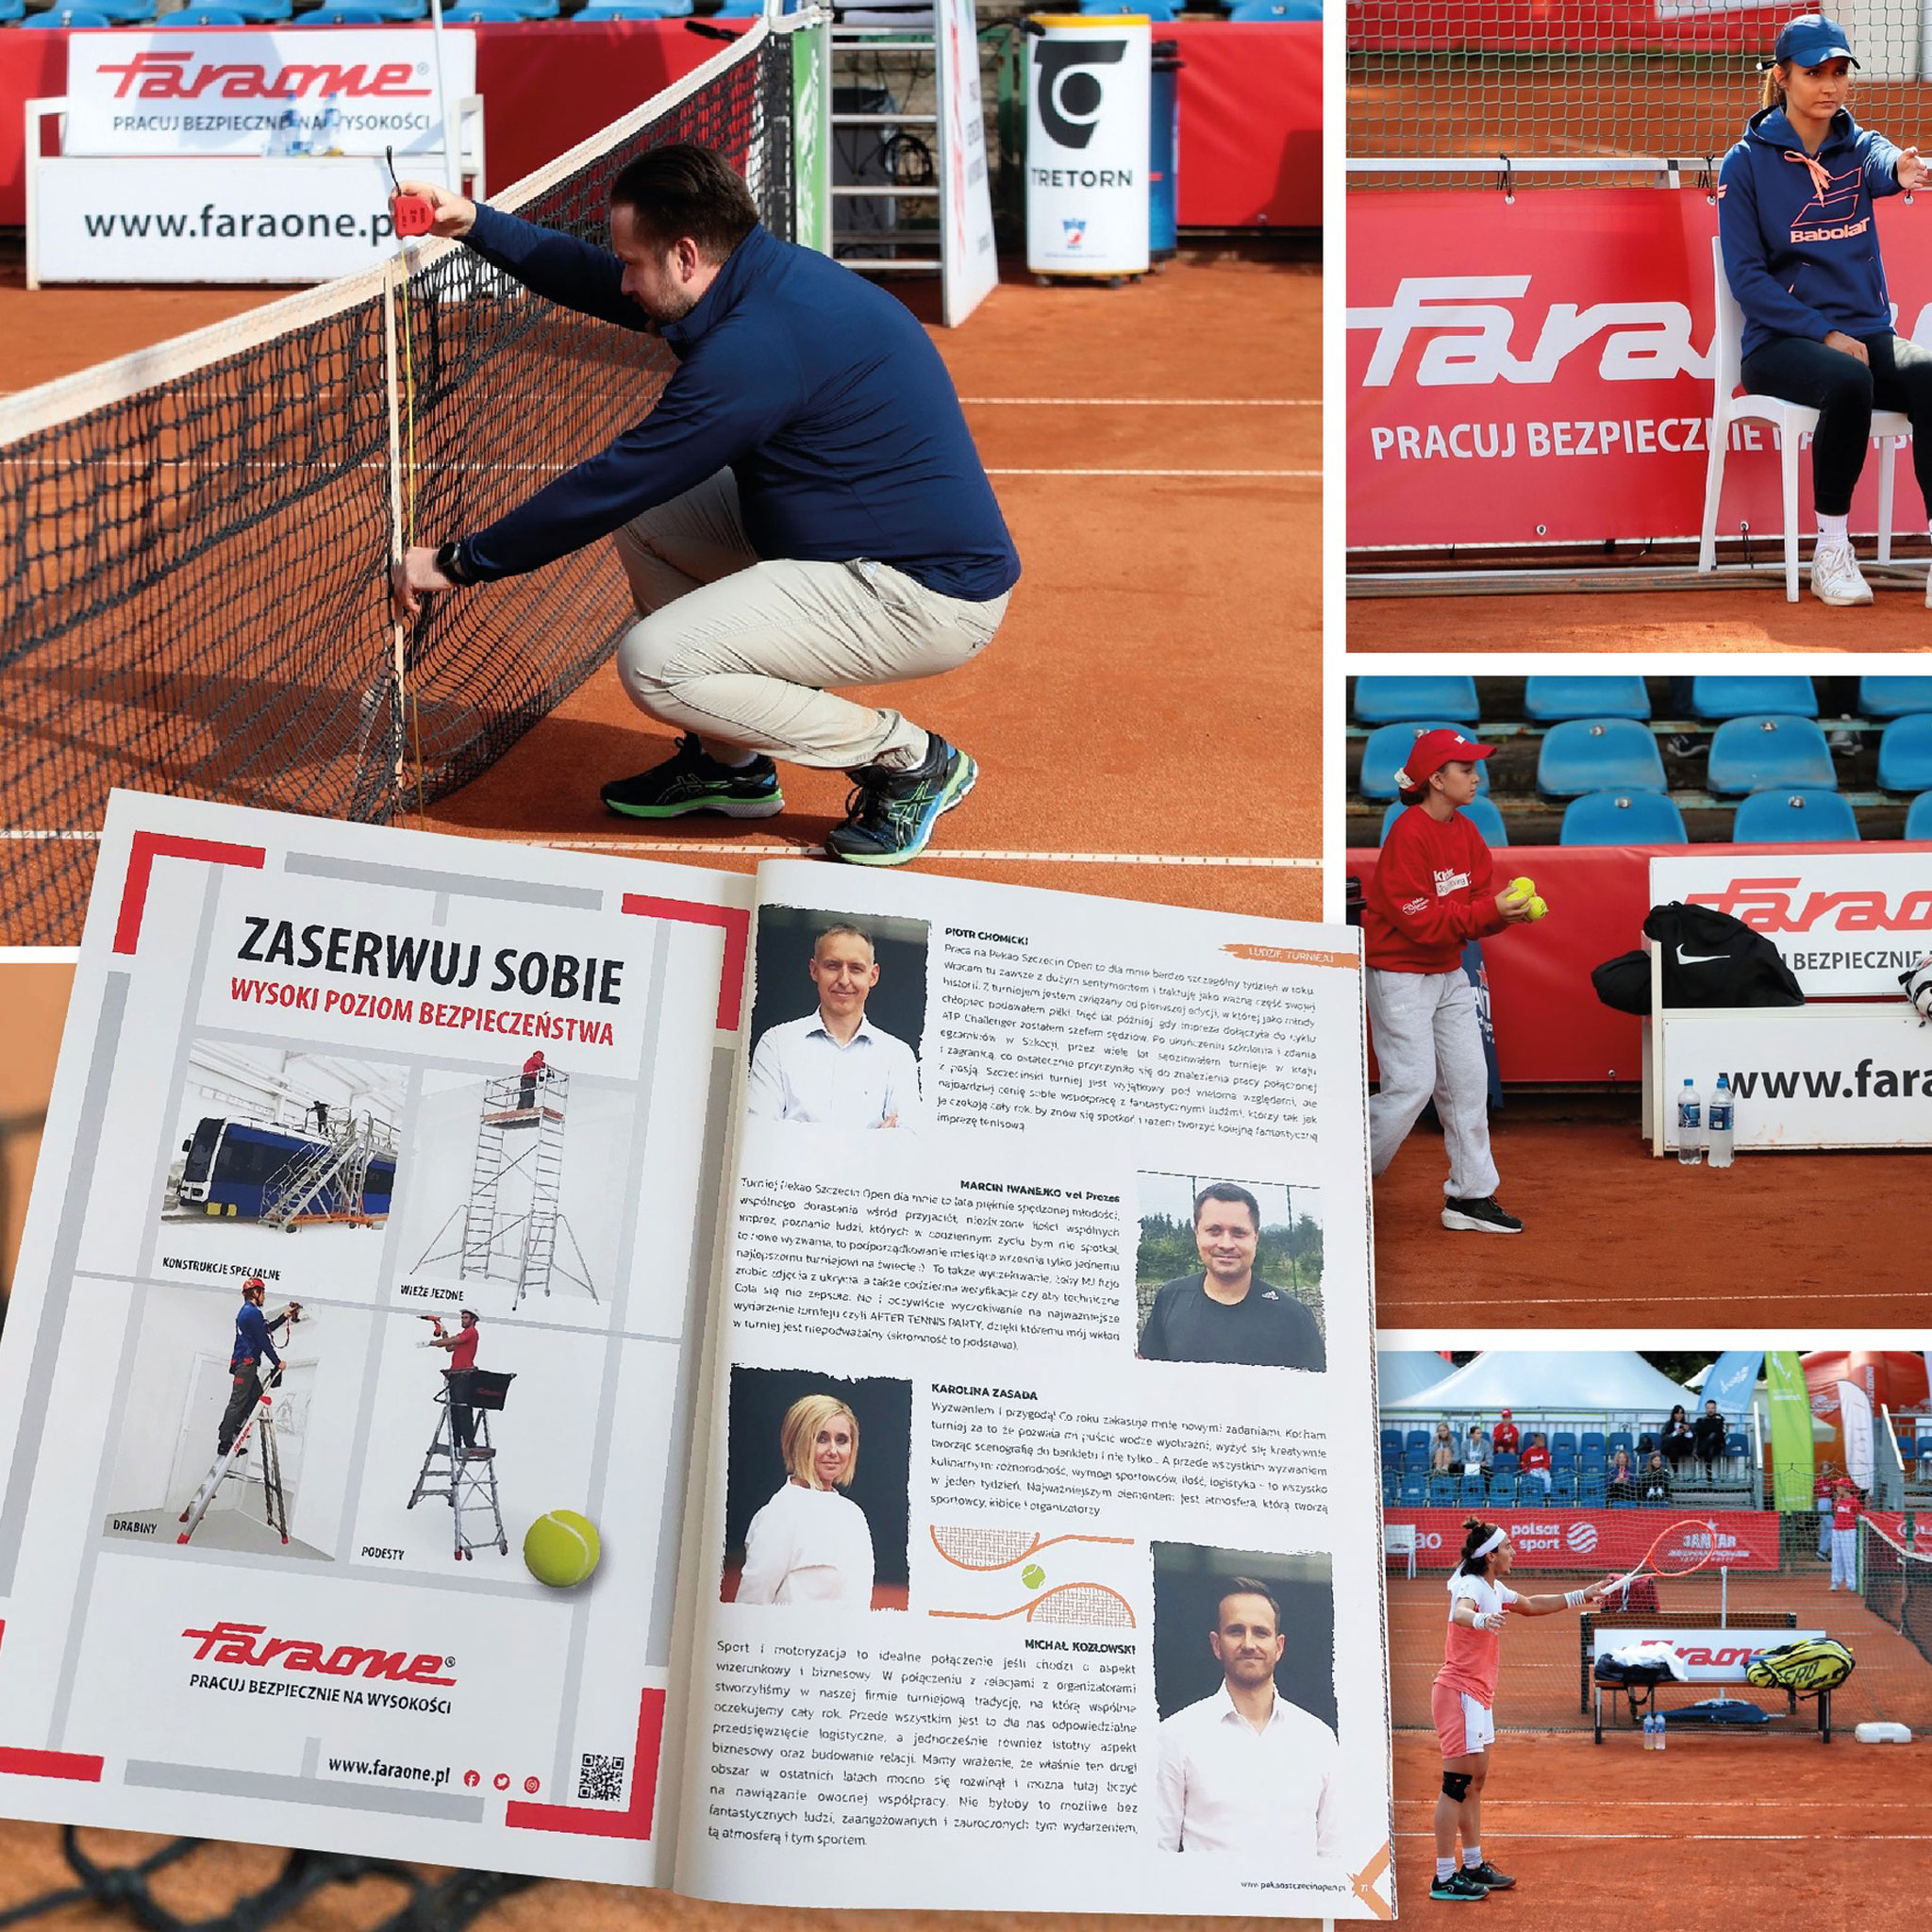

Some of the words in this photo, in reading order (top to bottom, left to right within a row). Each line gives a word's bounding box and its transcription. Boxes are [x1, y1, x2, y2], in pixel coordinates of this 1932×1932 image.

[113, 115, 179, 131] PRACUJ
[1032, 168, 1133, 188] TRETORN
[85, 204, 394, 247] www.faraone.p
[1371, 425, 1516, 460] PRACUJ
[238, 915, 481, 989] ZASERWUJ
[491, 948, 625, 1005] SOBIE
[230, 976, 318, 1008] WYSOKI
[325, 989, 413, 1023] POZIOM
[419, 1001, 615, 1046] BEZPIECZEŃSTWA
[959, 1179, 1004, 1193] MARCIN
[1064, 1190, 1083, 1200] vel
[162, 1257, 228, 1274] KONSTRUKCJE
[229, 1265, 281, 1281] SPECJALNE
[991, 1388, 1039, 1401] ZASADA
[112, 1519, 158, 1535] DRABINY
[1511, 1522, 1559, 1538] polsat
[360, 1545, 406, 1562] PODESTY
[1520, 1538, 1559, 1553] sport
[1024, 1638, 1070, 1652] MICHAŁ
[1071, 1641, 1137, 1656] KOZŁOWSKI
[190, 1674, 245, 1693] PRACUJ
[249, 1679, 341, 1704] BEZPIECZNIE
[343, 1690, 364, 1705] NA
[367, 1690, 451, 1715] WYSOKOŚCI
[328, 1757, 451, 1786] www.faraone.pl
